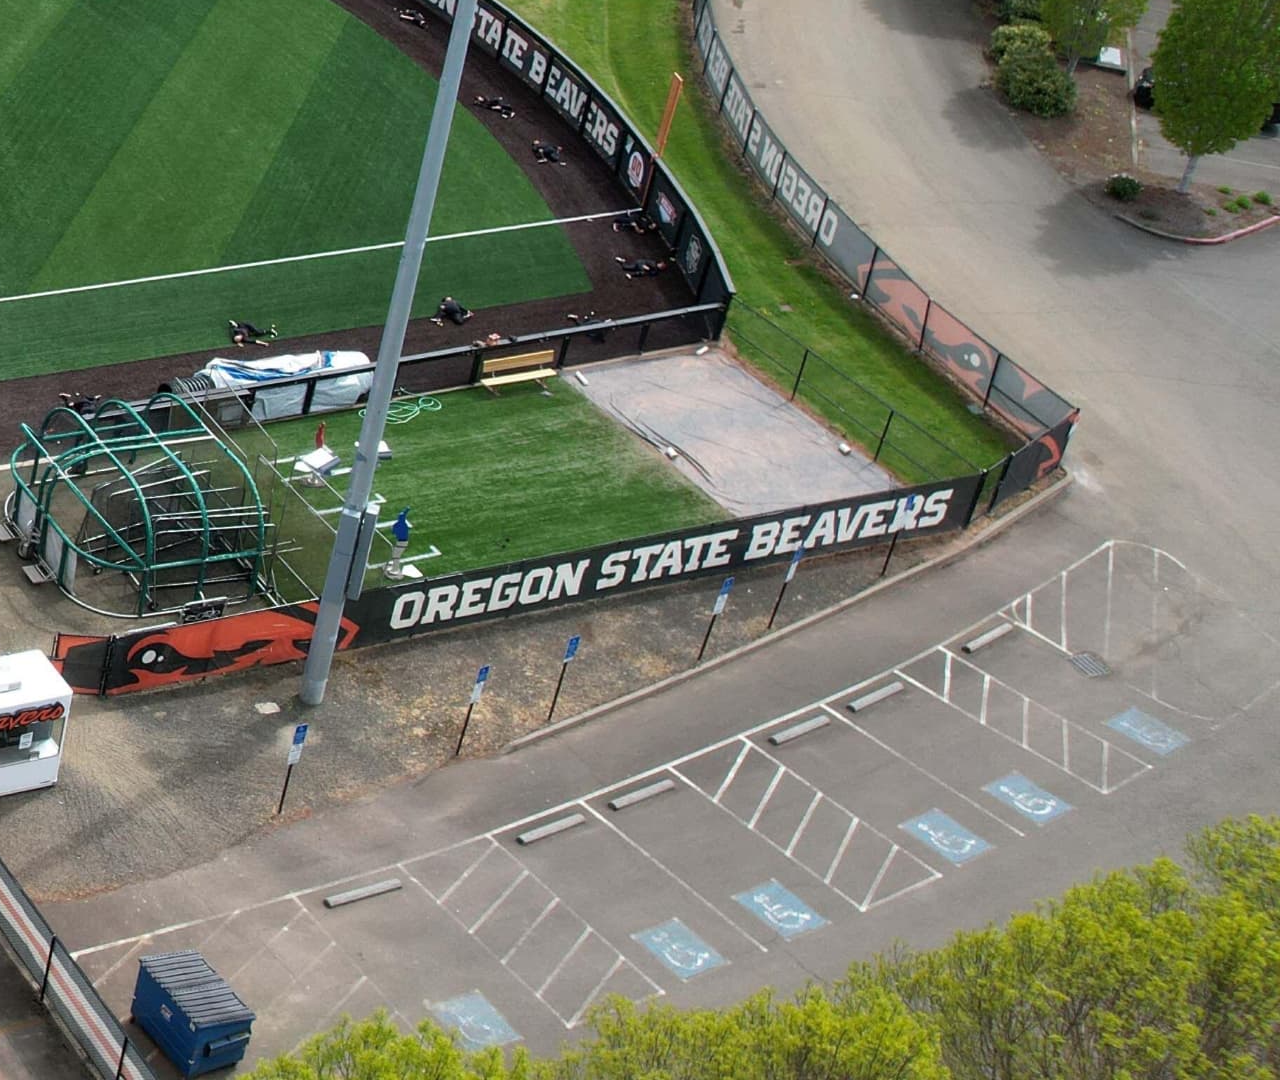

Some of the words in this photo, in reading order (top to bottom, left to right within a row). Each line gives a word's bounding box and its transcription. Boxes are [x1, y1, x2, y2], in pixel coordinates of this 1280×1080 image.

[390, 558, 590, 630] OREGON
[595, 529, 740, 591] STATE
[743, 487, 954, 562] BEAVERS
